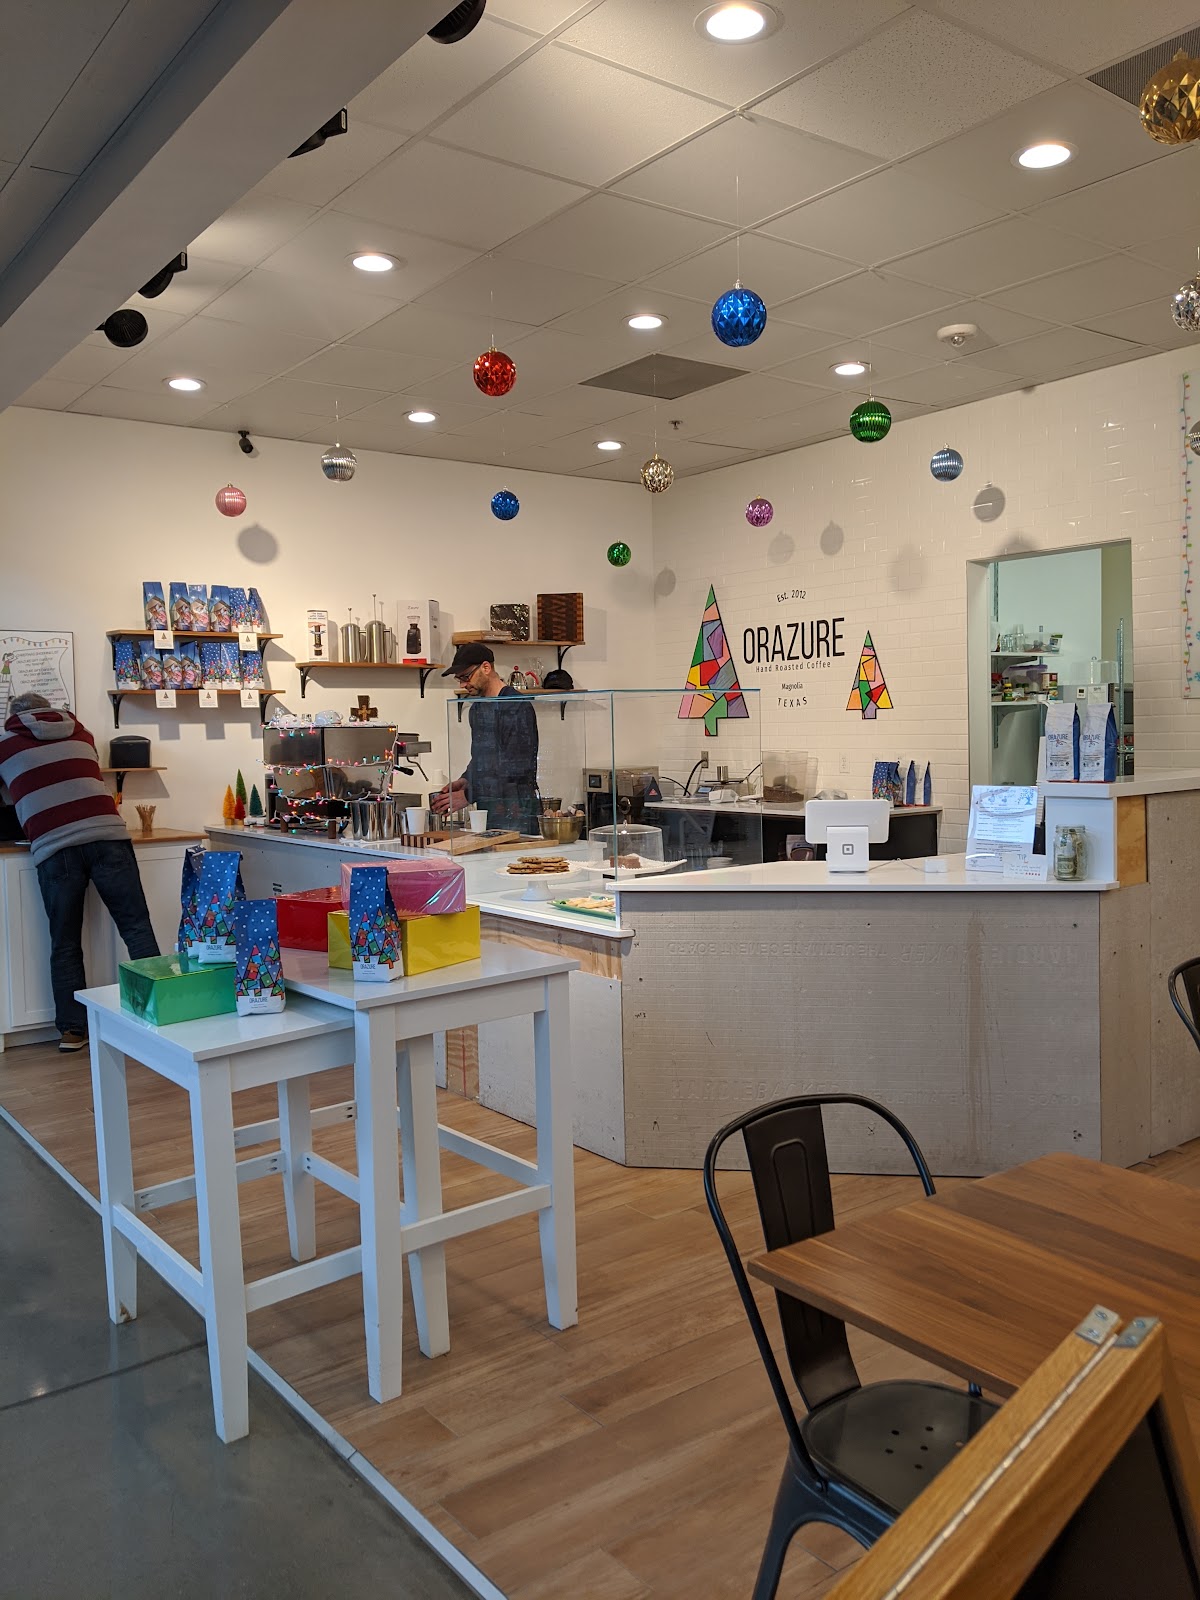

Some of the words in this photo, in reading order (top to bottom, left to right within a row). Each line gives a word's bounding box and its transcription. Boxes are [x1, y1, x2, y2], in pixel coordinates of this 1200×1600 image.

[777, 591, 789, 603] Est.
[791, 589, 807, 600] 2012
[743, 617, 845, 664] ORAZURE
[755, 665, 772, 673] Hand
[775, 662, 804, 671] Roasted
[807, 660, 831, 669] Coffee
[781, 681, 803, 691] Magnolia
[778, 696, 808, 708] TEXAS
[1083, 733, 1101, 741] ORAZURE
[249, 996, 268, 1004] ORAZURE
